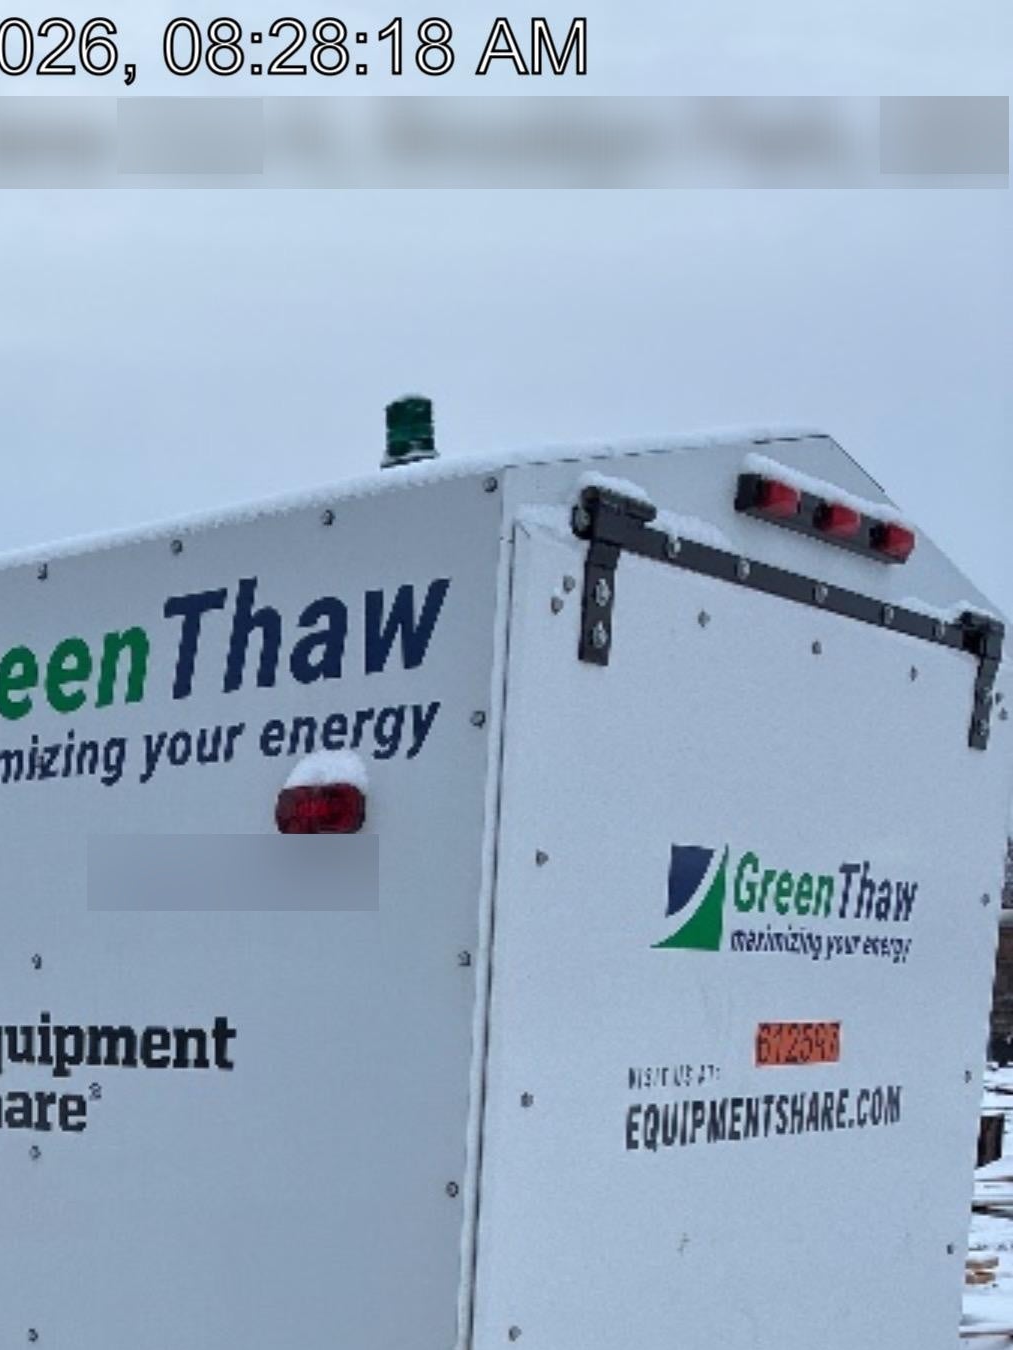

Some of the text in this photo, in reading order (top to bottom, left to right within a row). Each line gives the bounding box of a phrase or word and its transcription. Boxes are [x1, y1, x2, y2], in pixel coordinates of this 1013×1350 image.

[140, 720, 244, 783] your
[259, 701, 441, 760] energy
[734, 851, 919, 922] GreenThaw
[731, 924, 913, 964] maximizing your energy
[626, 1085, 902, 1152] EQUIPMENTSHARE.COM
